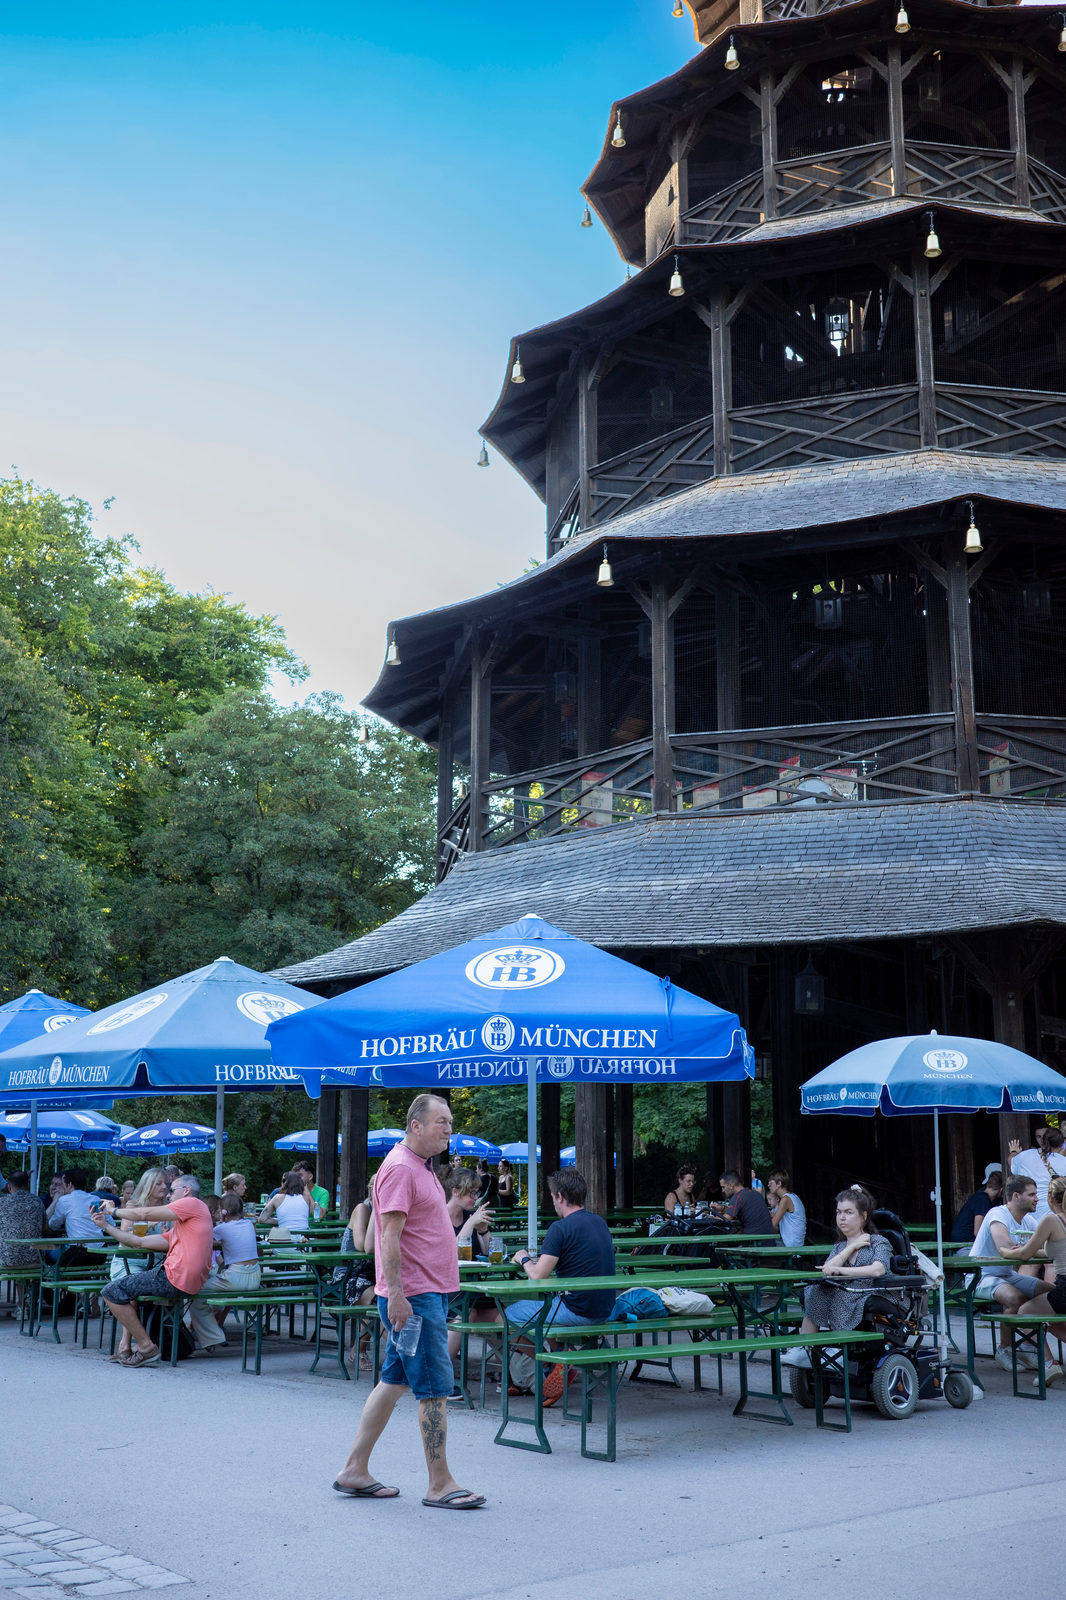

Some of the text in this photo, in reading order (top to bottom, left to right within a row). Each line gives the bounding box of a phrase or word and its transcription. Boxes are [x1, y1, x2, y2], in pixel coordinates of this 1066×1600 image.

[488, 966, 537, 982] HB
[360, 1024, 658, 1058] HOFBRÄU HB MÜNCHEN
[8, 1066, 49, 1086] HOFBRÄU
[61, 1064, 110, 1083] MÜNCHEN
[806, 1092, 839, 1103] HOFBRÄU
